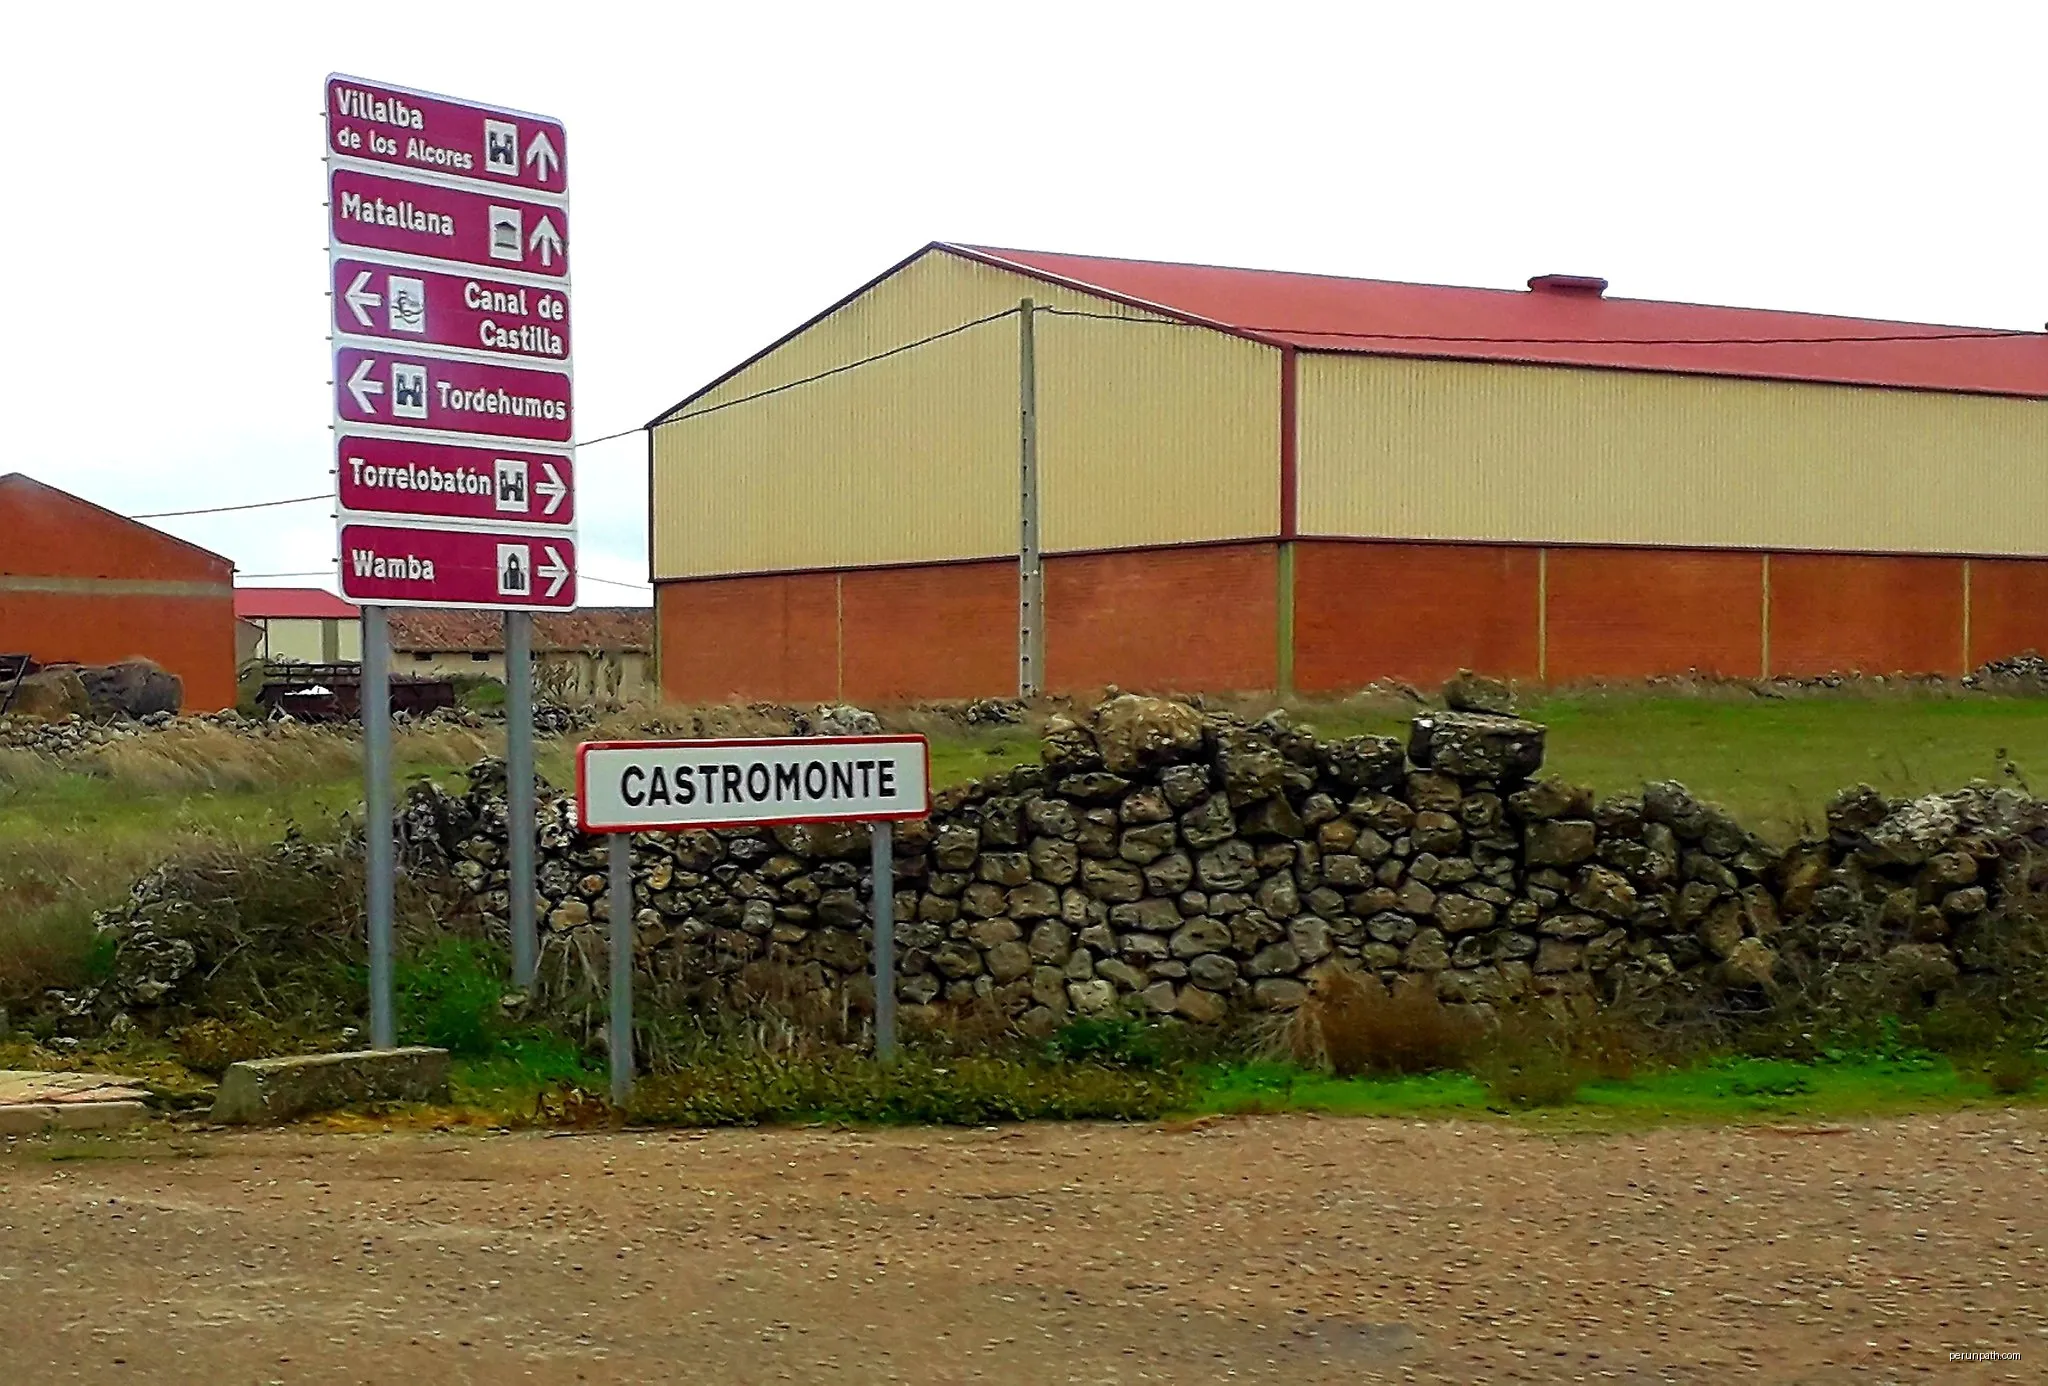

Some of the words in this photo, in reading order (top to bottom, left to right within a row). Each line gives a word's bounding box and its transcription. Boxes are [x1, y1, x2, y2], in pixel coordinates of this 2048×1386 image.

[335, 87, 424, 129] Villalba
[338, 128, 362, 150] de
[369, 131, 398, 156] los
[405, 138, 473, 169] Alcores
[341, 191, 454, 235] Matallana
[464, 281, 529, 316] Canal
[537, 294, 565, 321] de
[479, 319, 564, 355] Castilla
[436, 381, 566, 420] Tordehumos
[348, 457, 492, 495] Torrelobatón
[352, 549, 436, 581] Wamba
[621, 760, 896, 806] CASTROMONTE
